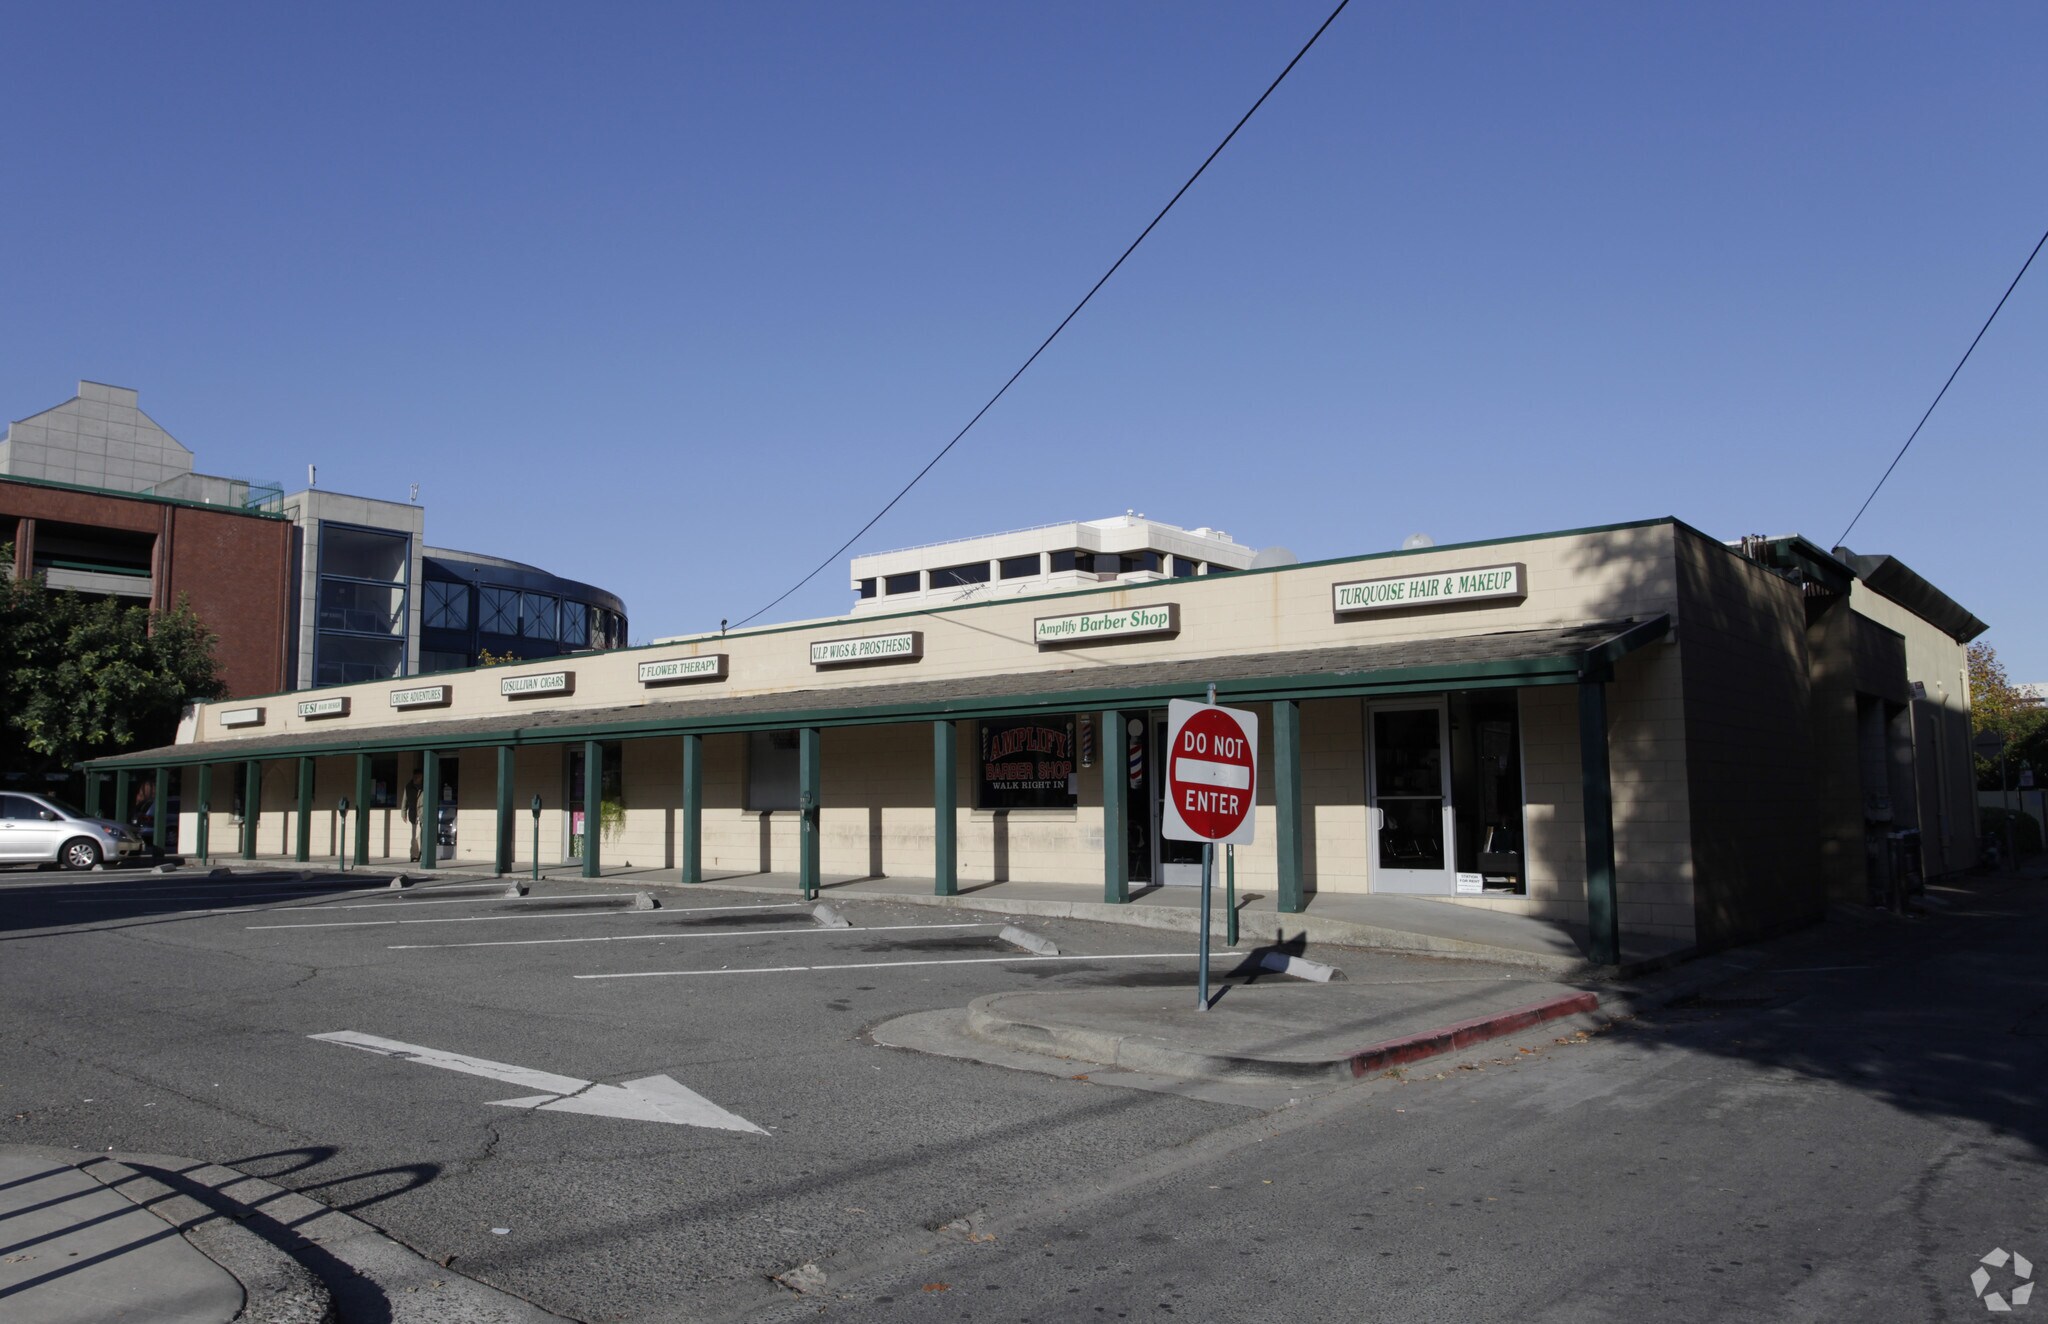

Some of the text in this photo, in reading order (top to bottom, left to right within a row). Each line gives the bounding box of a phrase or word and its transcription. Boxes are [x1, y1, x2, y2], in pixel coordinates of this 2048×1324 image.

[1340, 571, 1512, 605] TURQUOISE HAIR & MAKEUP
[1038, 610, 1168, 636] Amplify Barber Shop
[830, 644, 849, 658] WIGS
[851, 643, 857, 656] &
[859, 637, 911, 655] PROSTHESIS
[641, 659, 716, 677] 7 FLOWER THERAPY
[540, 676, 563, 688] CIGARS
[300, 703, 317, 714] VESI
[990, 727, 1067, 761] AMPLIFY
[1184, 730, 1244, 759] DO NOT
[986, 761, 1072, 780] BARBER SHOP
[1021, 781, 1051, 789] RIGHT
[1185, 789, 1239, 815] ENTER
